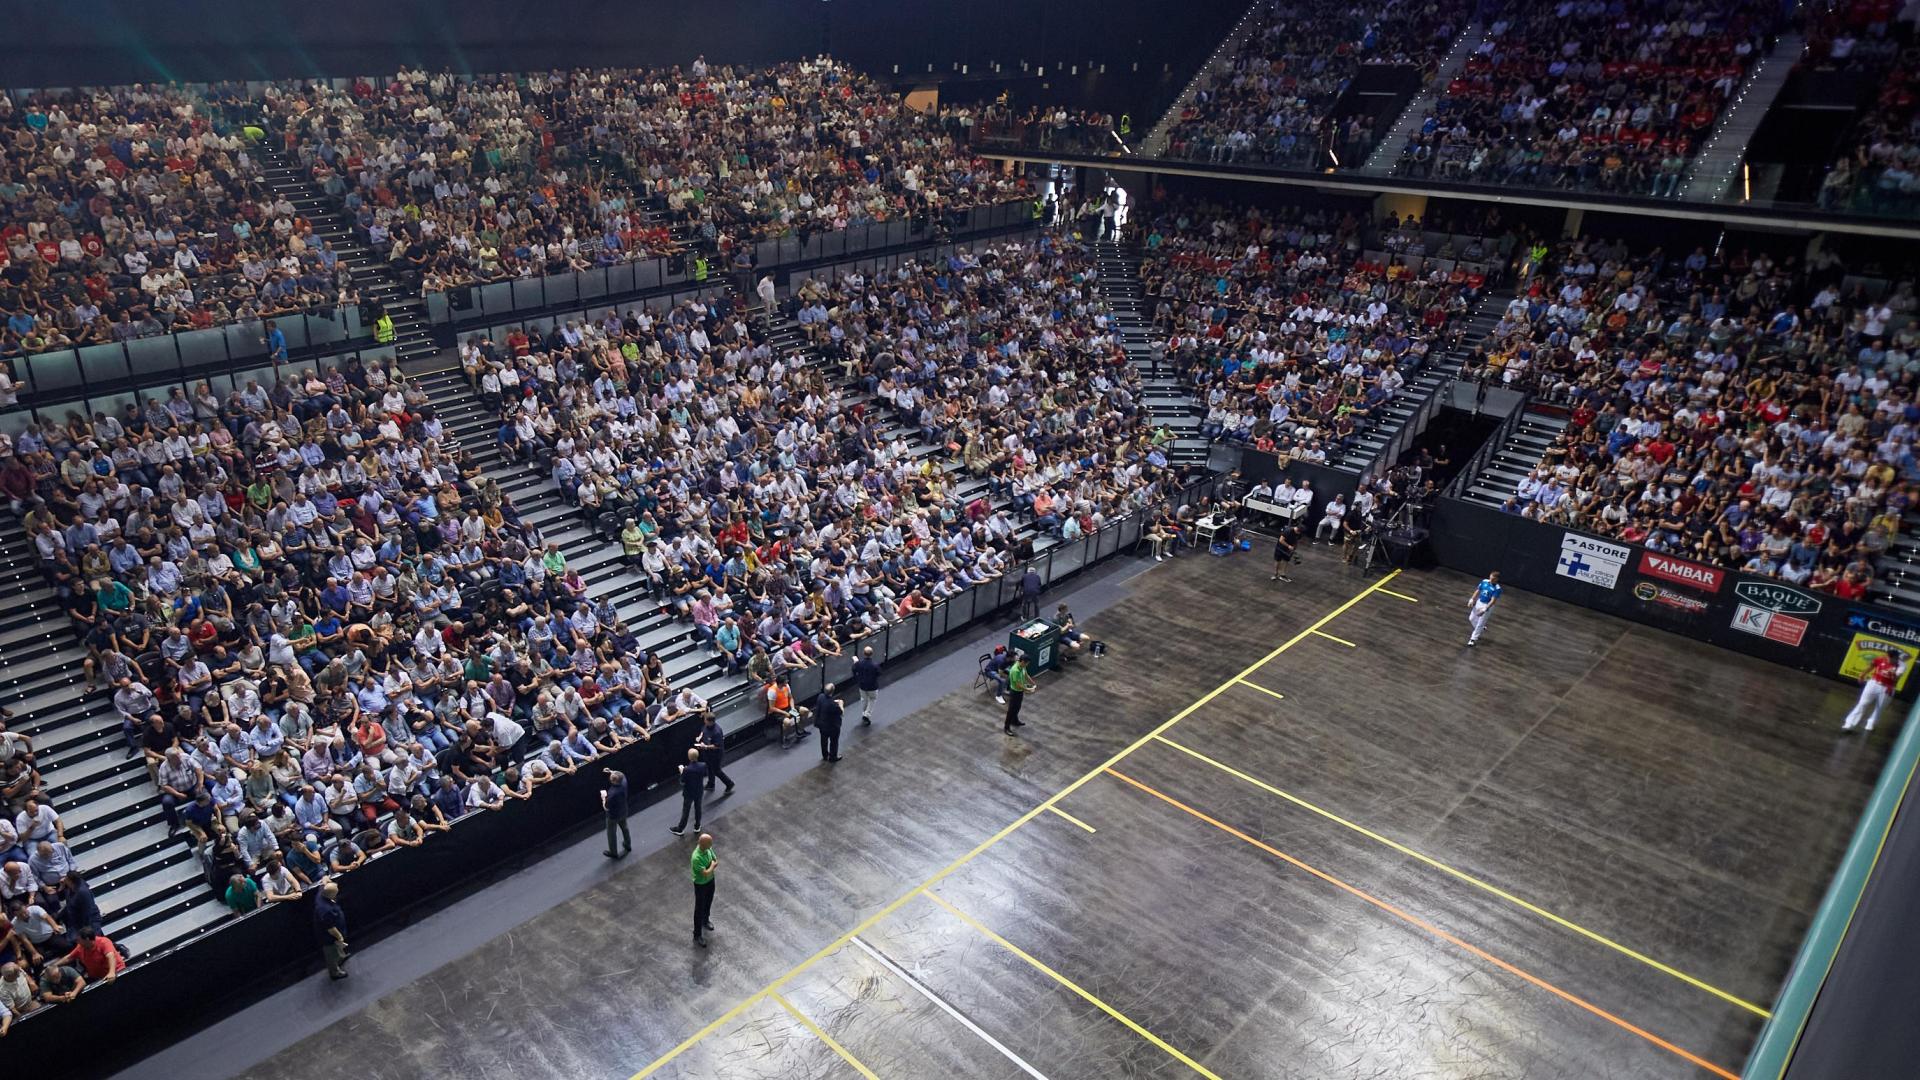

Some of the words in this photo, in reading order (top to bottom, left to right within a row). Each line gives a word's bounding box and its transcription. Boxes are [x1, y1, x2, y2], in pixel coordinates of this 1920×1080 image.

[1579, 541, 1627, 559] ASTORE
[1658, 561, 1713, 584] AMBAR
[1747, 586, 1810, 610] BAQUÉ
